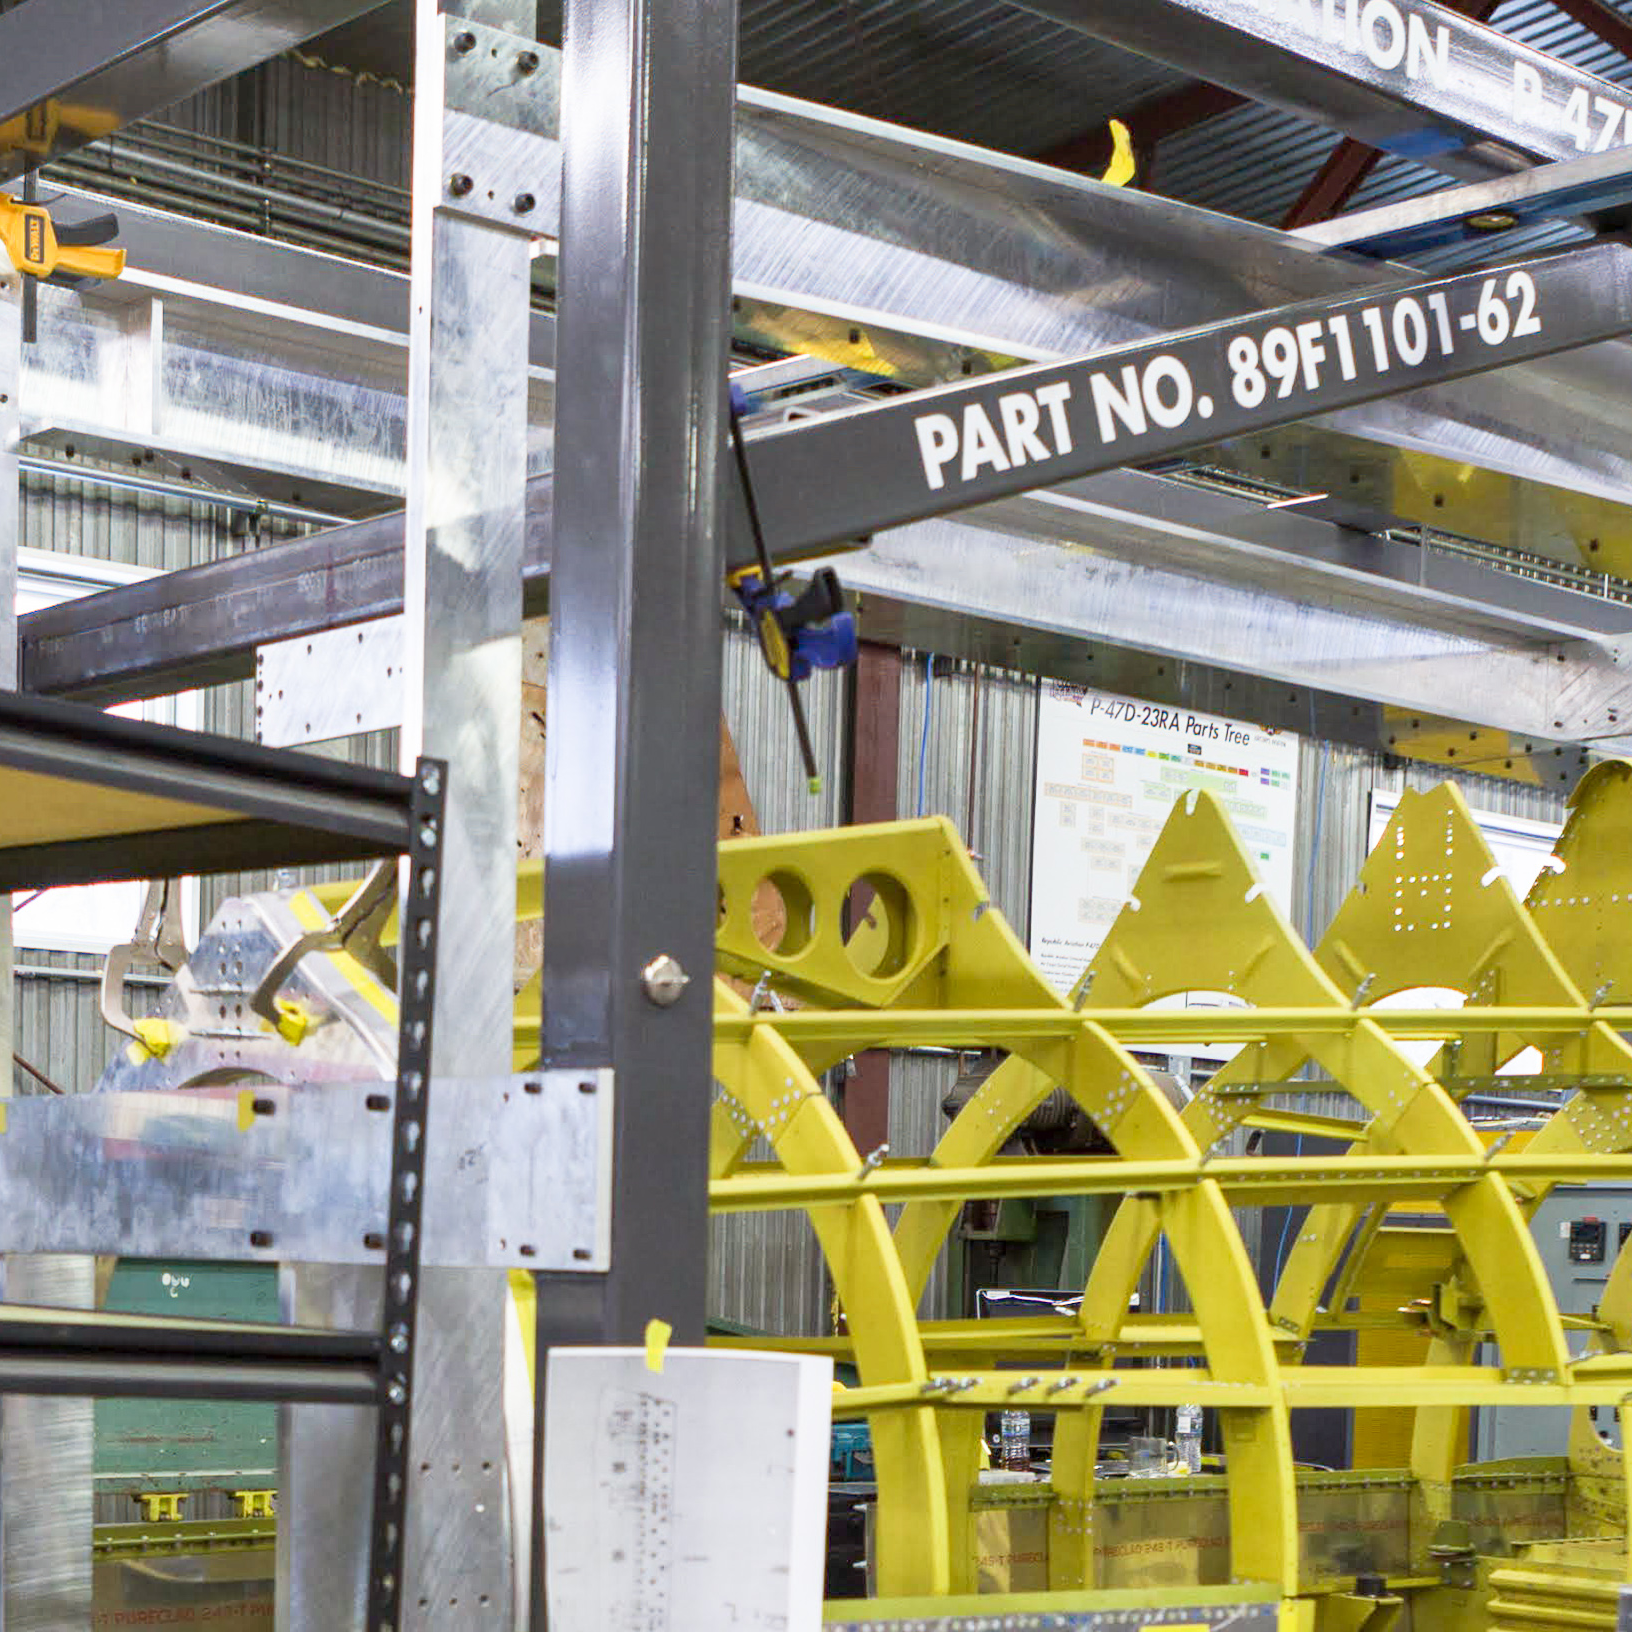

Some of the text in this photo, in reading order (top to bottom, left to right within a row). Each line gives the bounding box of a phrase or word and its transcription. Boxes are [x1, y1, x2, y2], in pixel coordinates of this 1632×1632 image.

[914, 270, 1542, 490] PART NO. 89F1101-62
[1090, 698, 1179, 732] P-47D-23RA
[1185, 715, 1219, 740] Parts
[1224, 723, 1251, 746] Tree
